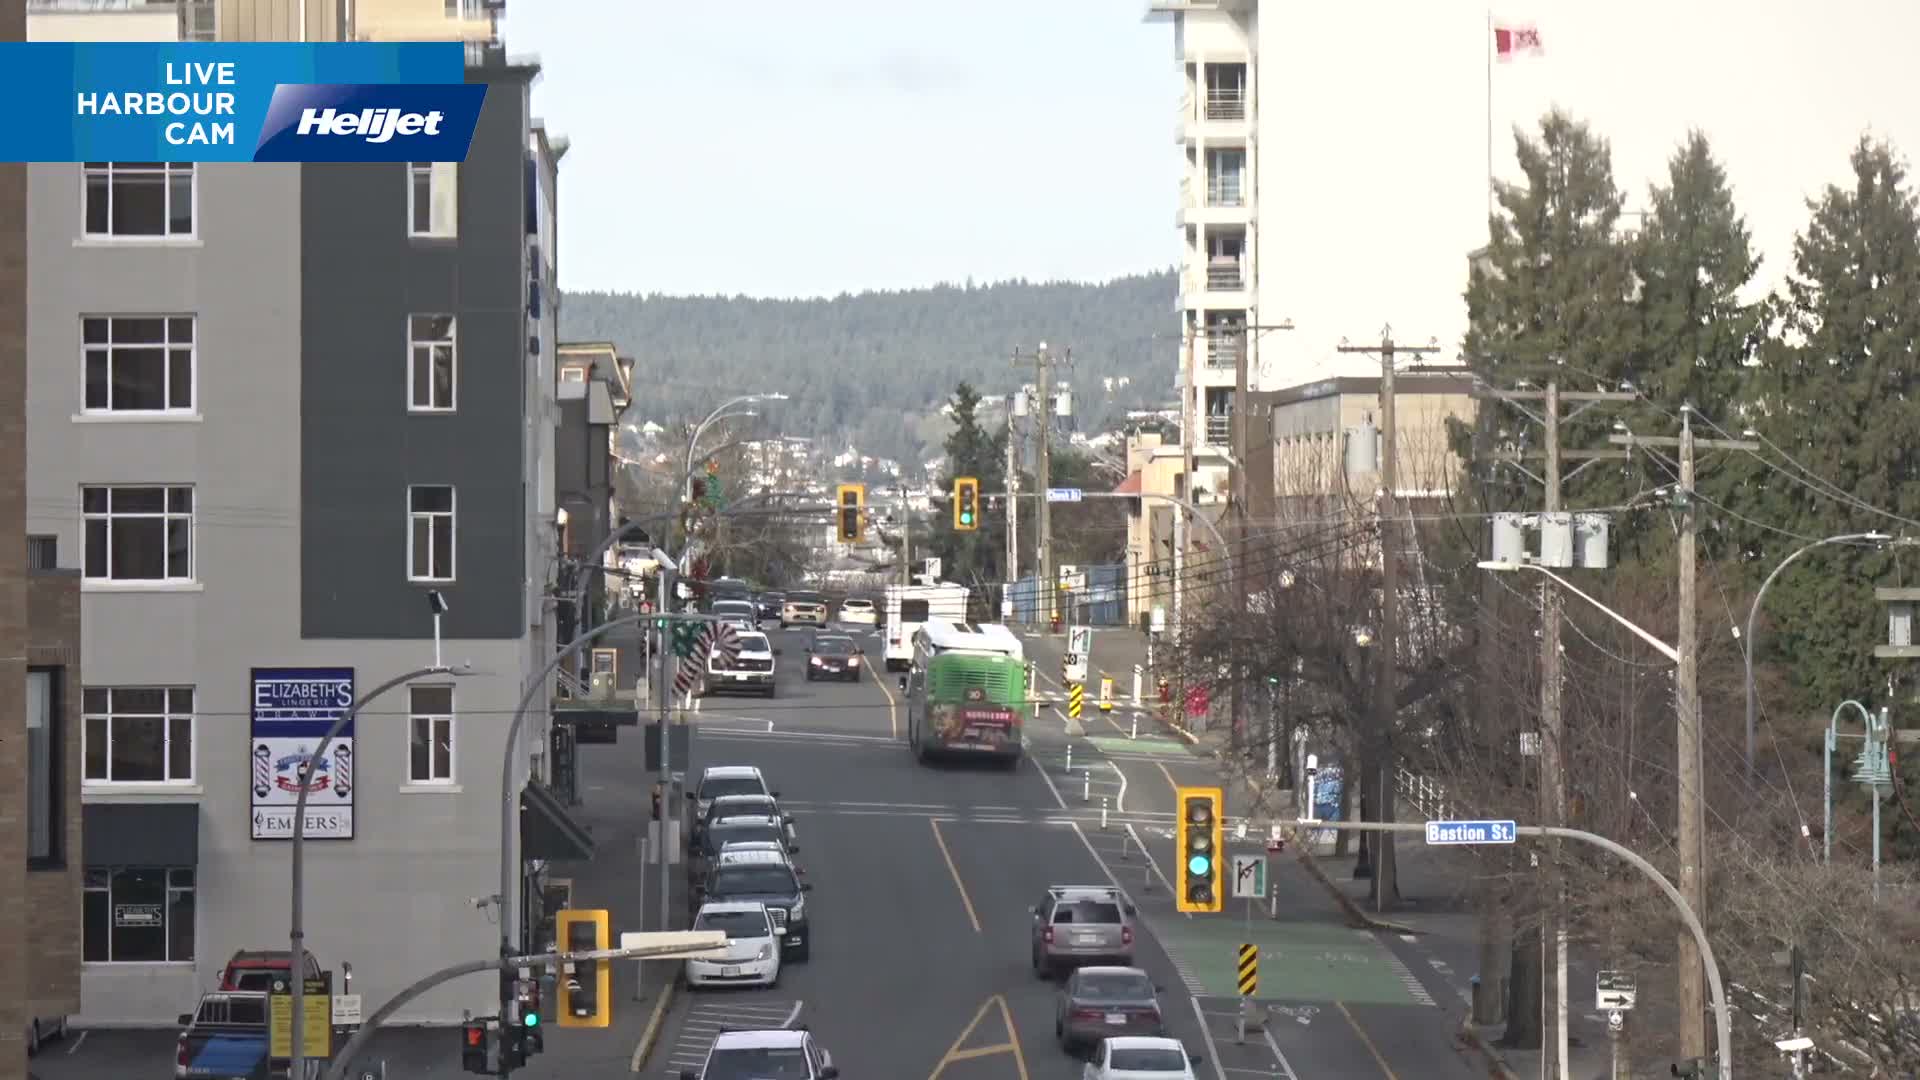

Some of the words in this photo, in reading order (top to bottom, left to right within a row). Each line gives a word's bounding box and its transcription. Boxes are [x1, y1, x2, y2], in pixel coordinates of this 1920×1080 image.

[255, 683, 352, 707] ELIZABETH'S
[267, 816, 338, 830] EMERS
[1429, 824, 1485, 841] Bastion
[1491, 824, 1513, 841] St.
